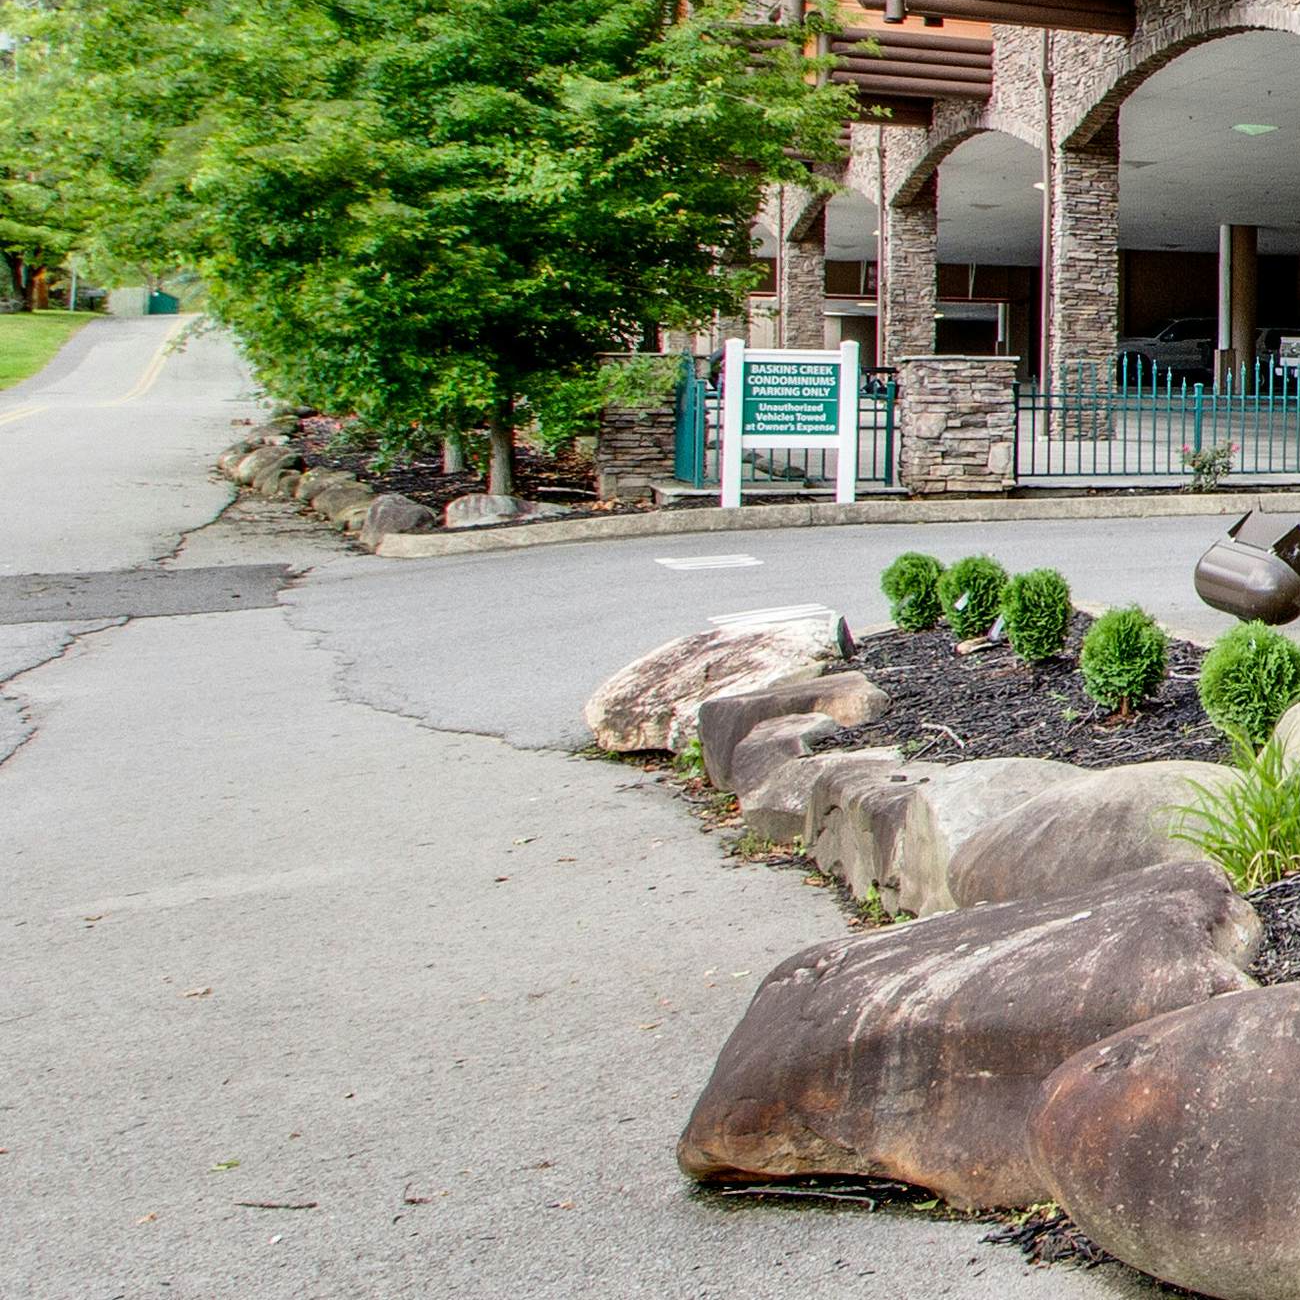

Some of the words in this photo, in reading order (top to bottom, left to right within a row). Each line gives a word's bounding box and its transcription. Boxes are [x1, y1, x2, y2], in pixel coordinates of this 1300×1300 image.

[751, 364, 798, 374] BASKINS
[799, 365, 833, 375] CREEK
[748, 375, 836, 386] CONDOMINIUMS
[752, 386, 800, 396] PARKING
[802, 387, 831, 397] ONLY
[758, 403, 824, 412] Unauthorized
[755, 412, 795, 421] Vehicles
[795, 413, 827, 422] Towed
[745, 423, 756, 431] at
[756, 422, 795, 431] Owner's
[796, 423, 836, 433] Expense
